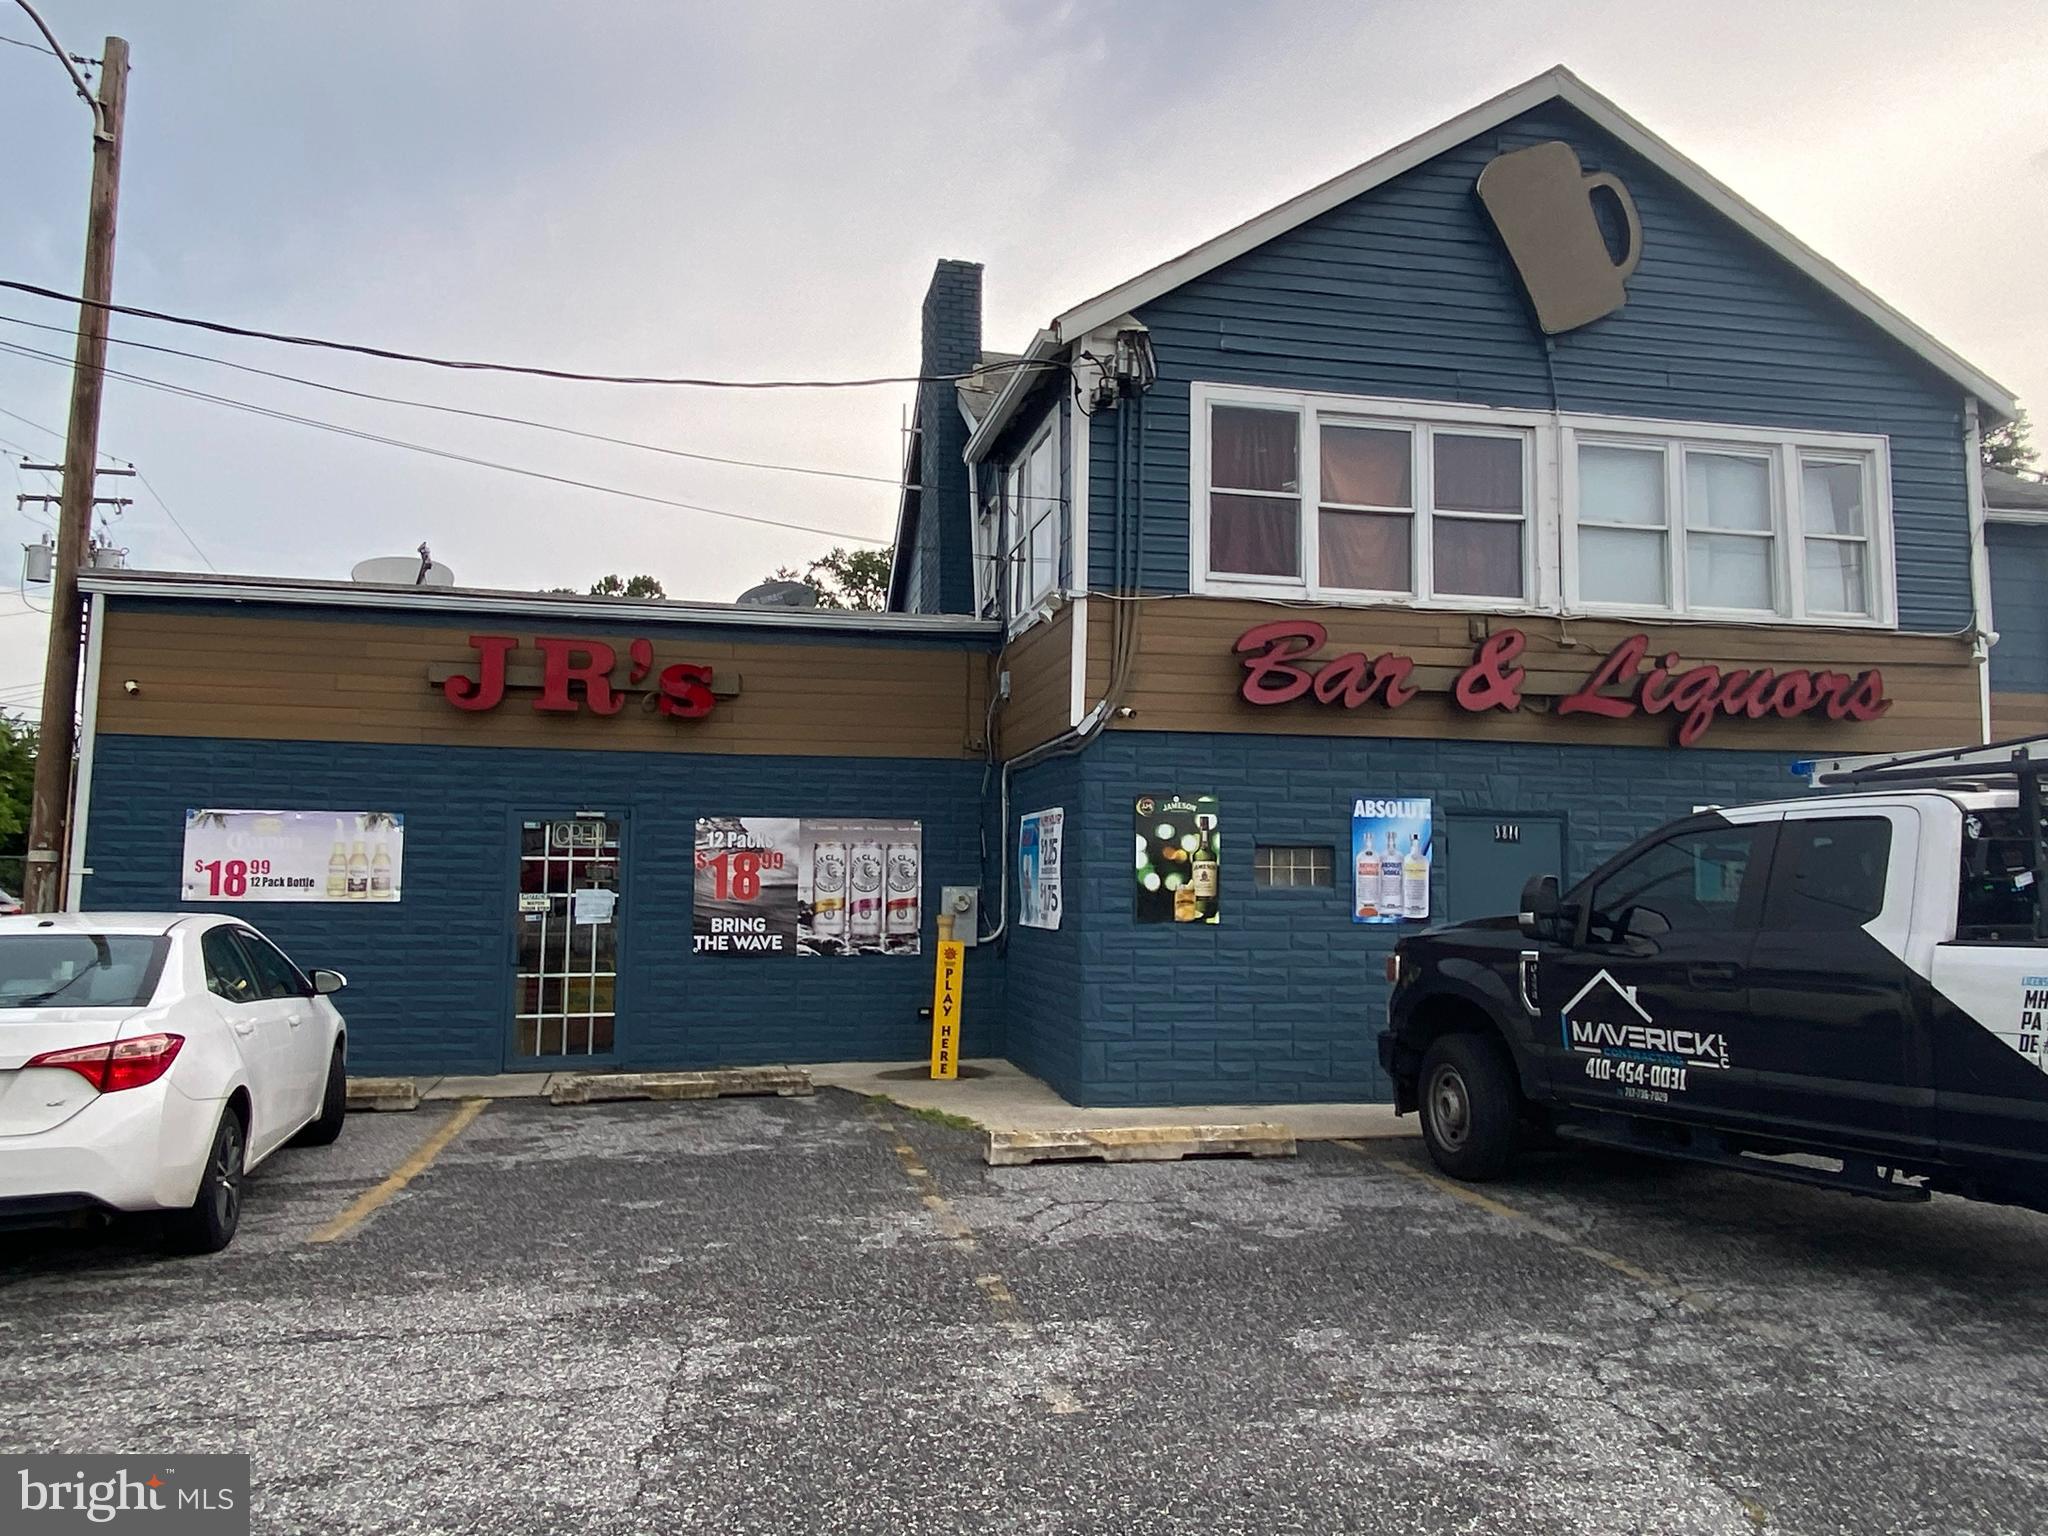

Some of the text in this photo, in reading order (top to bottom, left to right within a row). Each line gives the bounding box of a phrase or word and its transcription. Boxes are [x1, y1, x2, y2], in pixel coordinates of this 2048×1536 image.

[444, 635, 716, 717] JR's
[1233, 620, 1892, 748] Bar & Liquors
[1163, 802, 1197, 812] JAMESON
[556, 824, 604, 845] OPEN
[707, 831, 775, 848] 12 Packs
[250, 876, 315, 887] 12 Pack Bottle
[711, 917, 766, 933] BRING
[693, 935, 783, 950] THE WAVE
[943, 968, 953, 1016] PLAY
[2021, 1012, 2041, 1031] PA
[940, 1026, 951, 1074] HERE
[1572, 1020, 1730, 1069] MAVERICK LLC
[2019, 1034, 2040, 1053] DE
[1585, 1057, 1687, 1091] 410-454-0031
